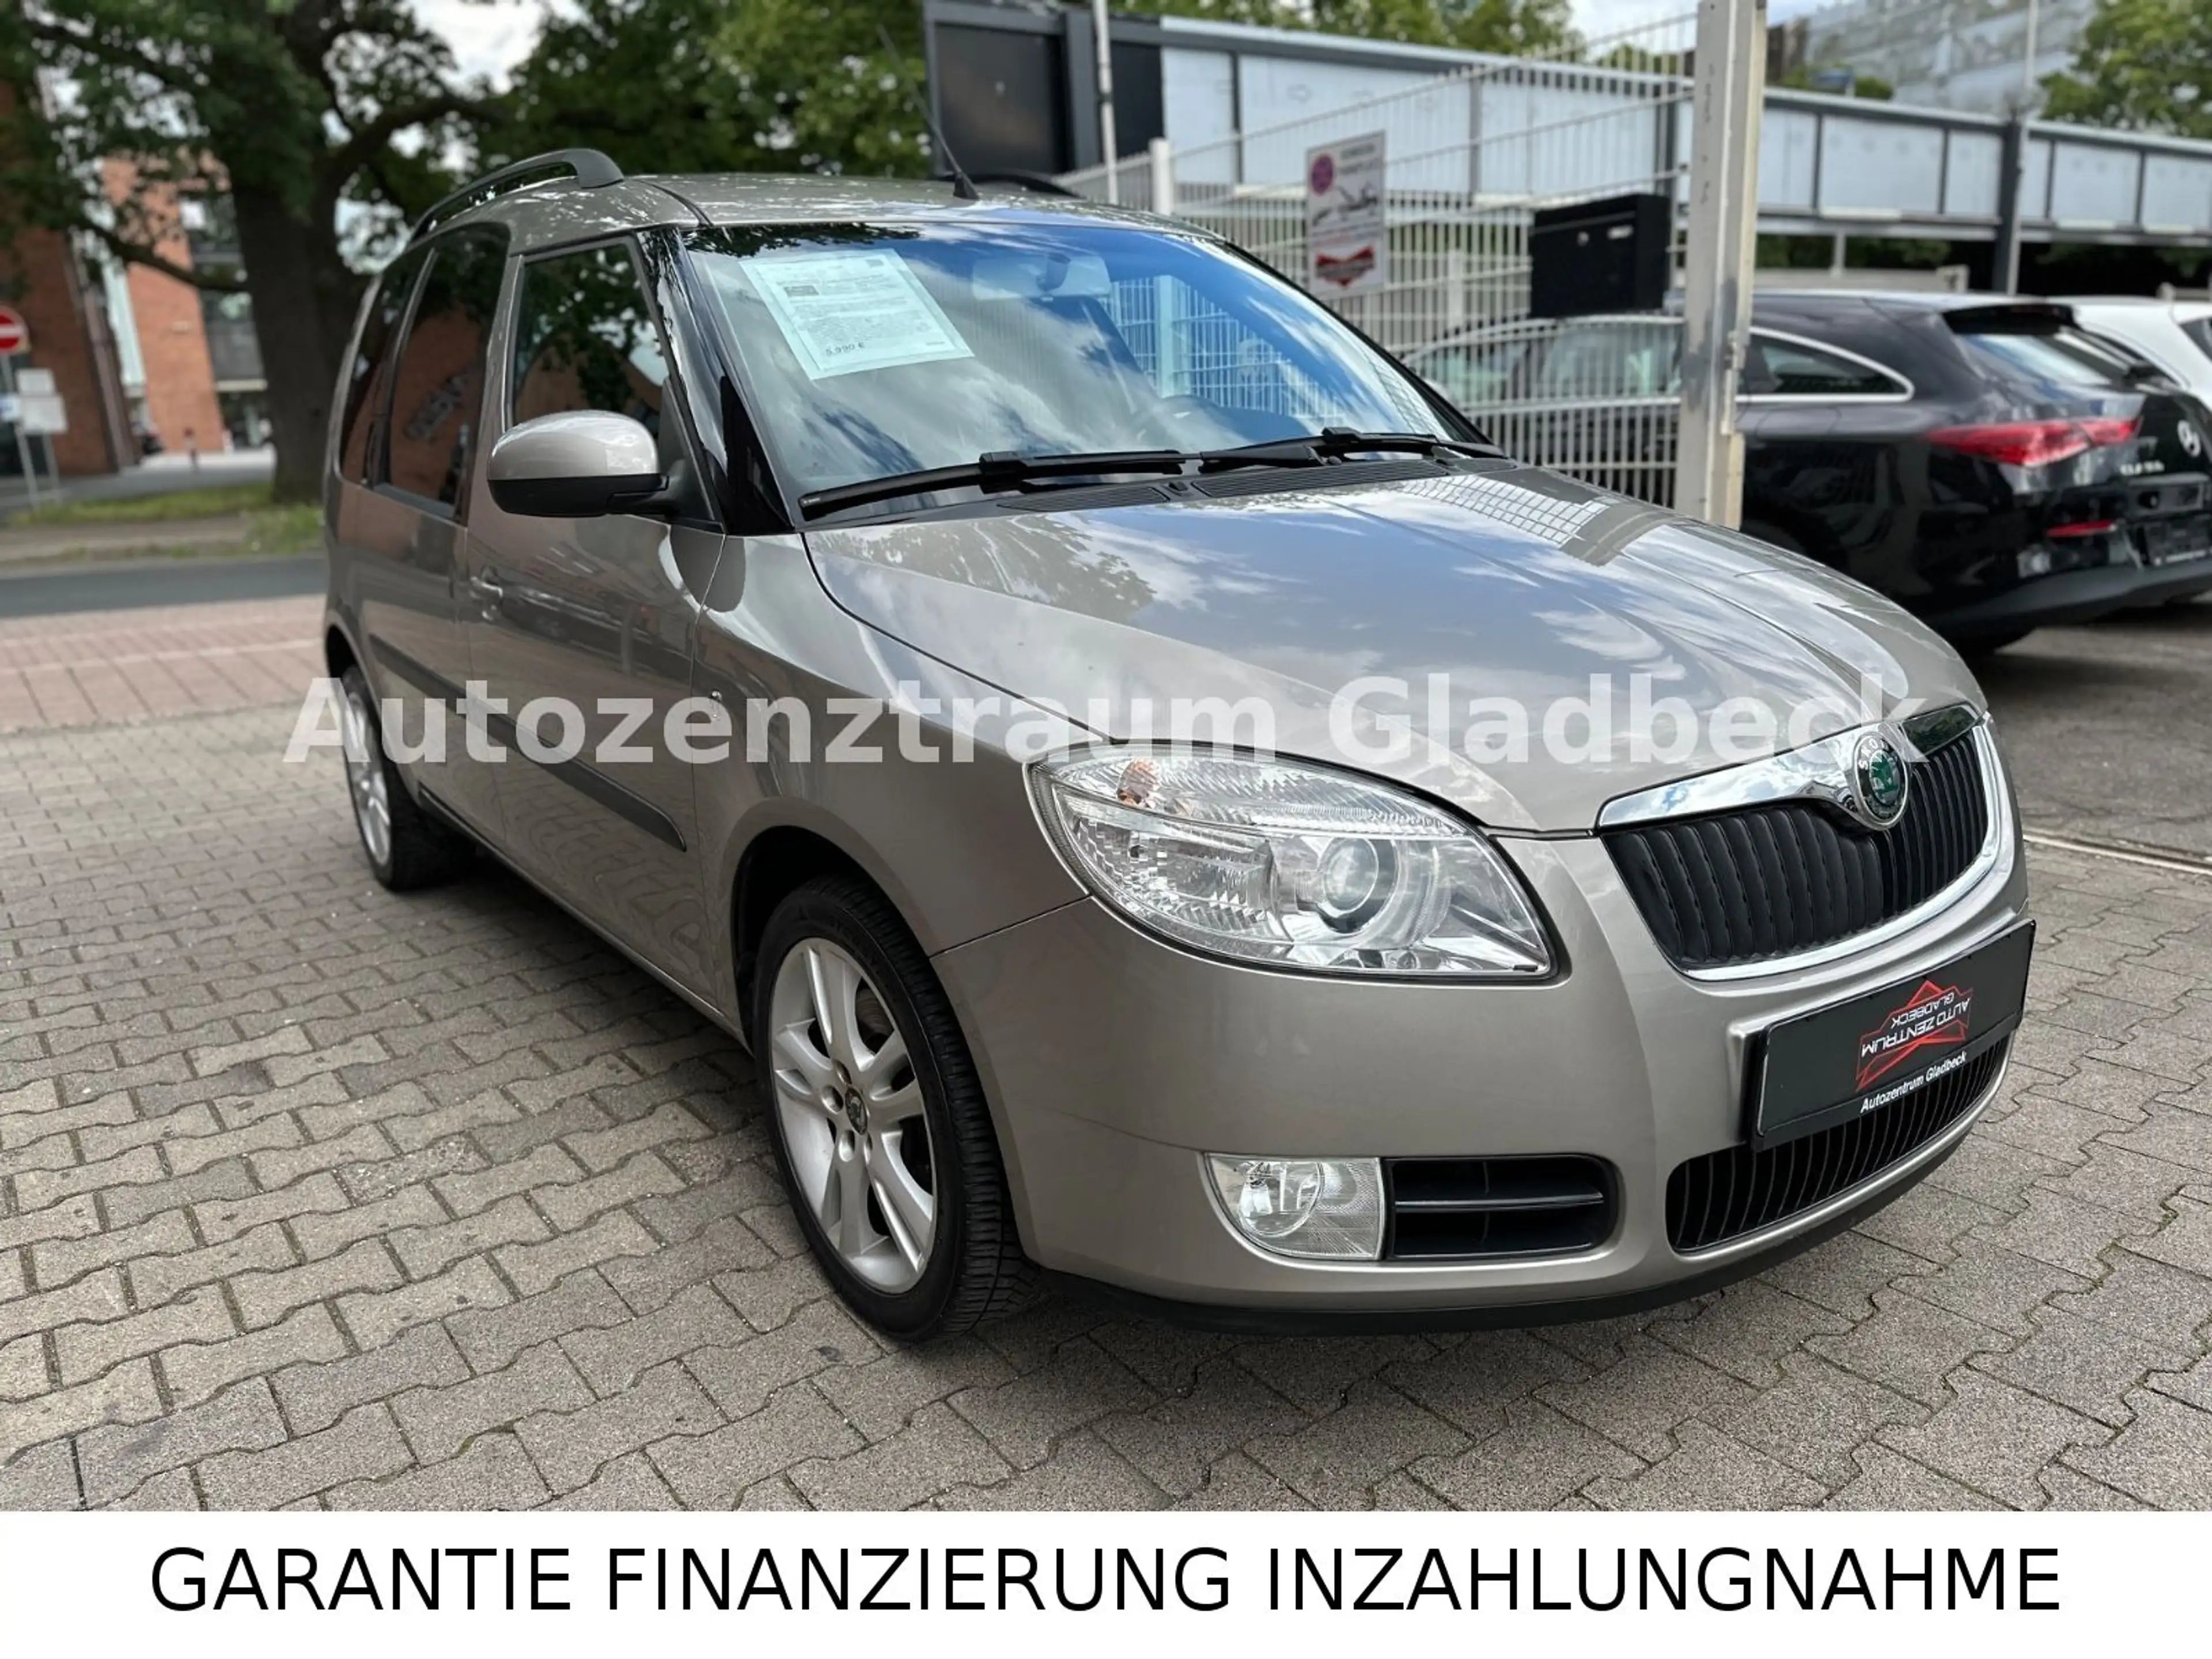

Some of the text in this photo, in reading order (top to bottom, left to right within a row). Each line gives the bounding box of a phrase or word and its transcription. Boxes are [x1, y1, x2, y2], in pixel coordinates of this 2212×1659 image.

[1861, 998, 1971, 1058] AUTO ZENTRUM
[1891, 992, 1955, 1029] GLADBECK
[1860, 1051, 1967, 1113] Autozentrum Gladbeck
